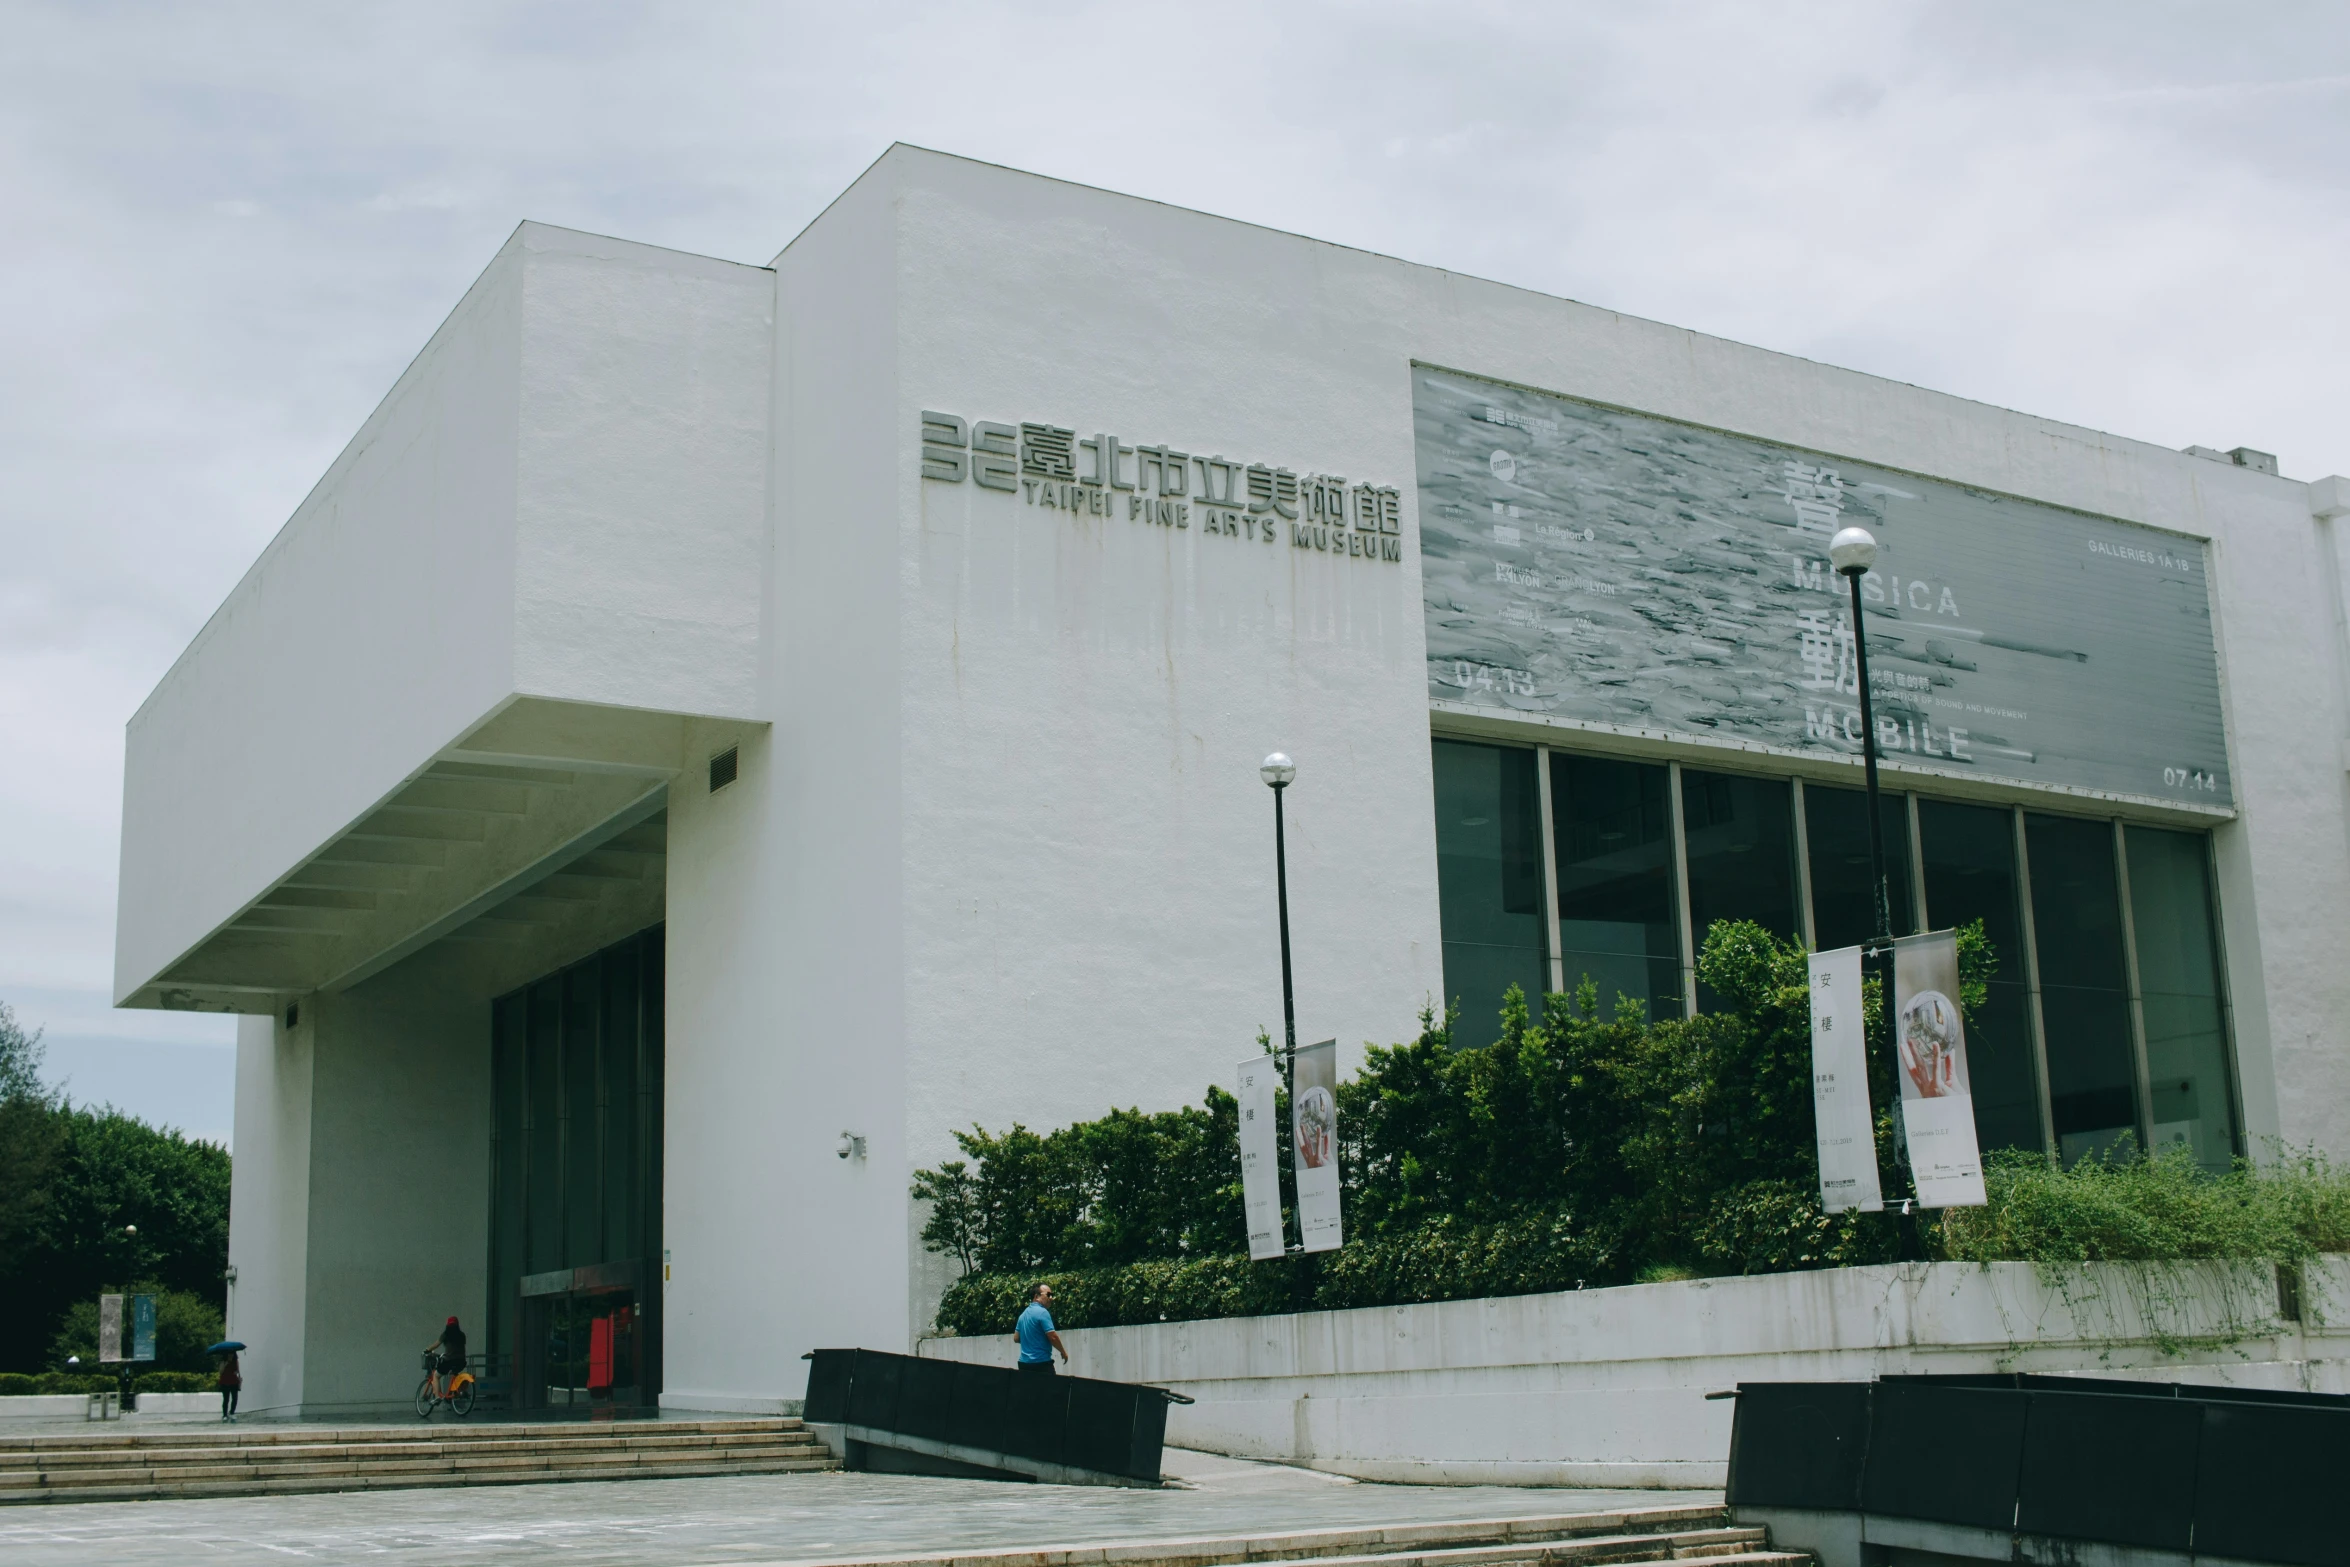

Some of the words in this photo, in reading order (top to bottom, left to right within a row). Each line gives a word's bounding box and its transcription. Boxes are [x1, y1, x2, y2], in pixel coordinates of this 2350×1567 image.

[1020, 421, 1404, 536] 臺北市立美術館
[1022, 478, 1113, 518] TAIPEI
[1129, 495, 1190, 529] FINE
[1204, 508, 1277, 543] ARTS
[1291, 523, 1402, 563] MUSEUM
[1535, 522, 1547, 535] La
[1548, 526, 1582, 541] Région
[2088, 539, 2155, 565] GALLERIES
[2158, 555, 2173, 569] 1A
[2175, 559, 2190, 572] 1B
[1513, 573, 1540, 588] LYON
[1793, 557, 1960, 617] MUSICA
[1797, 609, 1860, 697] 動
[1454, 660, 1535, 696] 04.13
[1870, 667, 1931, 692] 光與音的詩
[1873, 688, 1880, 697] A
[1881, 689, 1919, 703] POETICS
[1921, 696, 1933, 705] OF
[1935, 697, 1964, 711] SOUND
[1966, 703, 1983, 714] AND
[1984, 706, 2028, 721] MOVEMENT
[1804, 704, 1973, 761] MOBILE
[2163, 767, 2216, 792] 07.14
